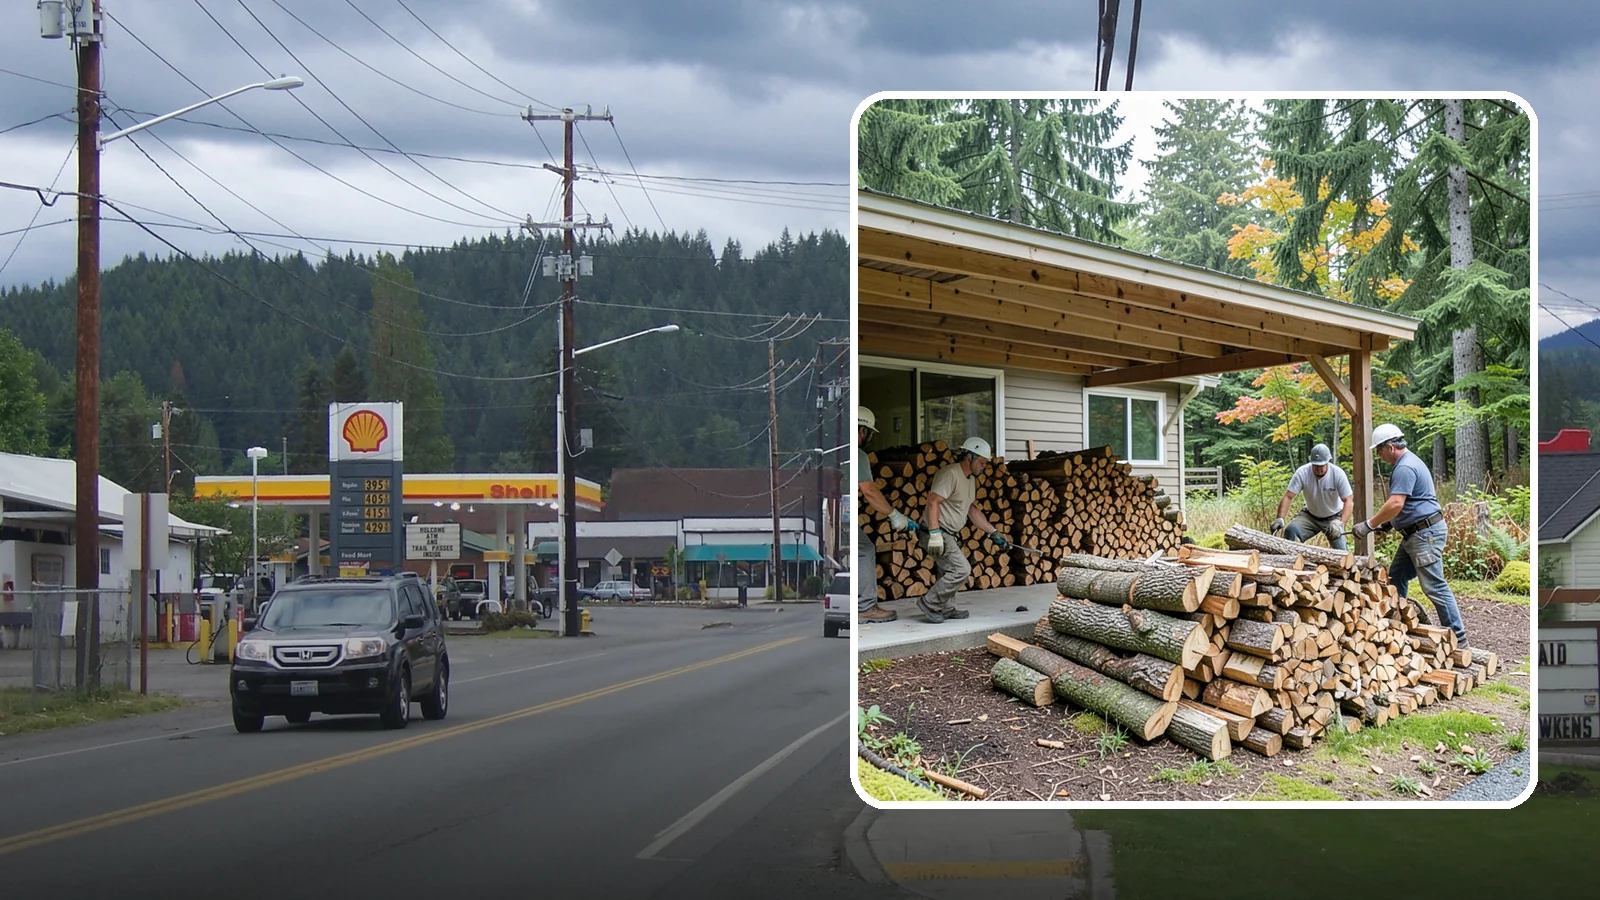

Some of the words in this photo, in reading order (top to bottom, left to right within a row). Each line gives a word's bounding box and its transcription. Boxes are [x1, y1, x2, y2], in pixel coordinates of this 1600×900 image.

[366, 480, 383, 490] 395
[490, 485, 547, 499] Shell
[366, 494, 383, 504] 405
[366, 508, 383, 518] 415
[366, 522, 383, 532] 429
